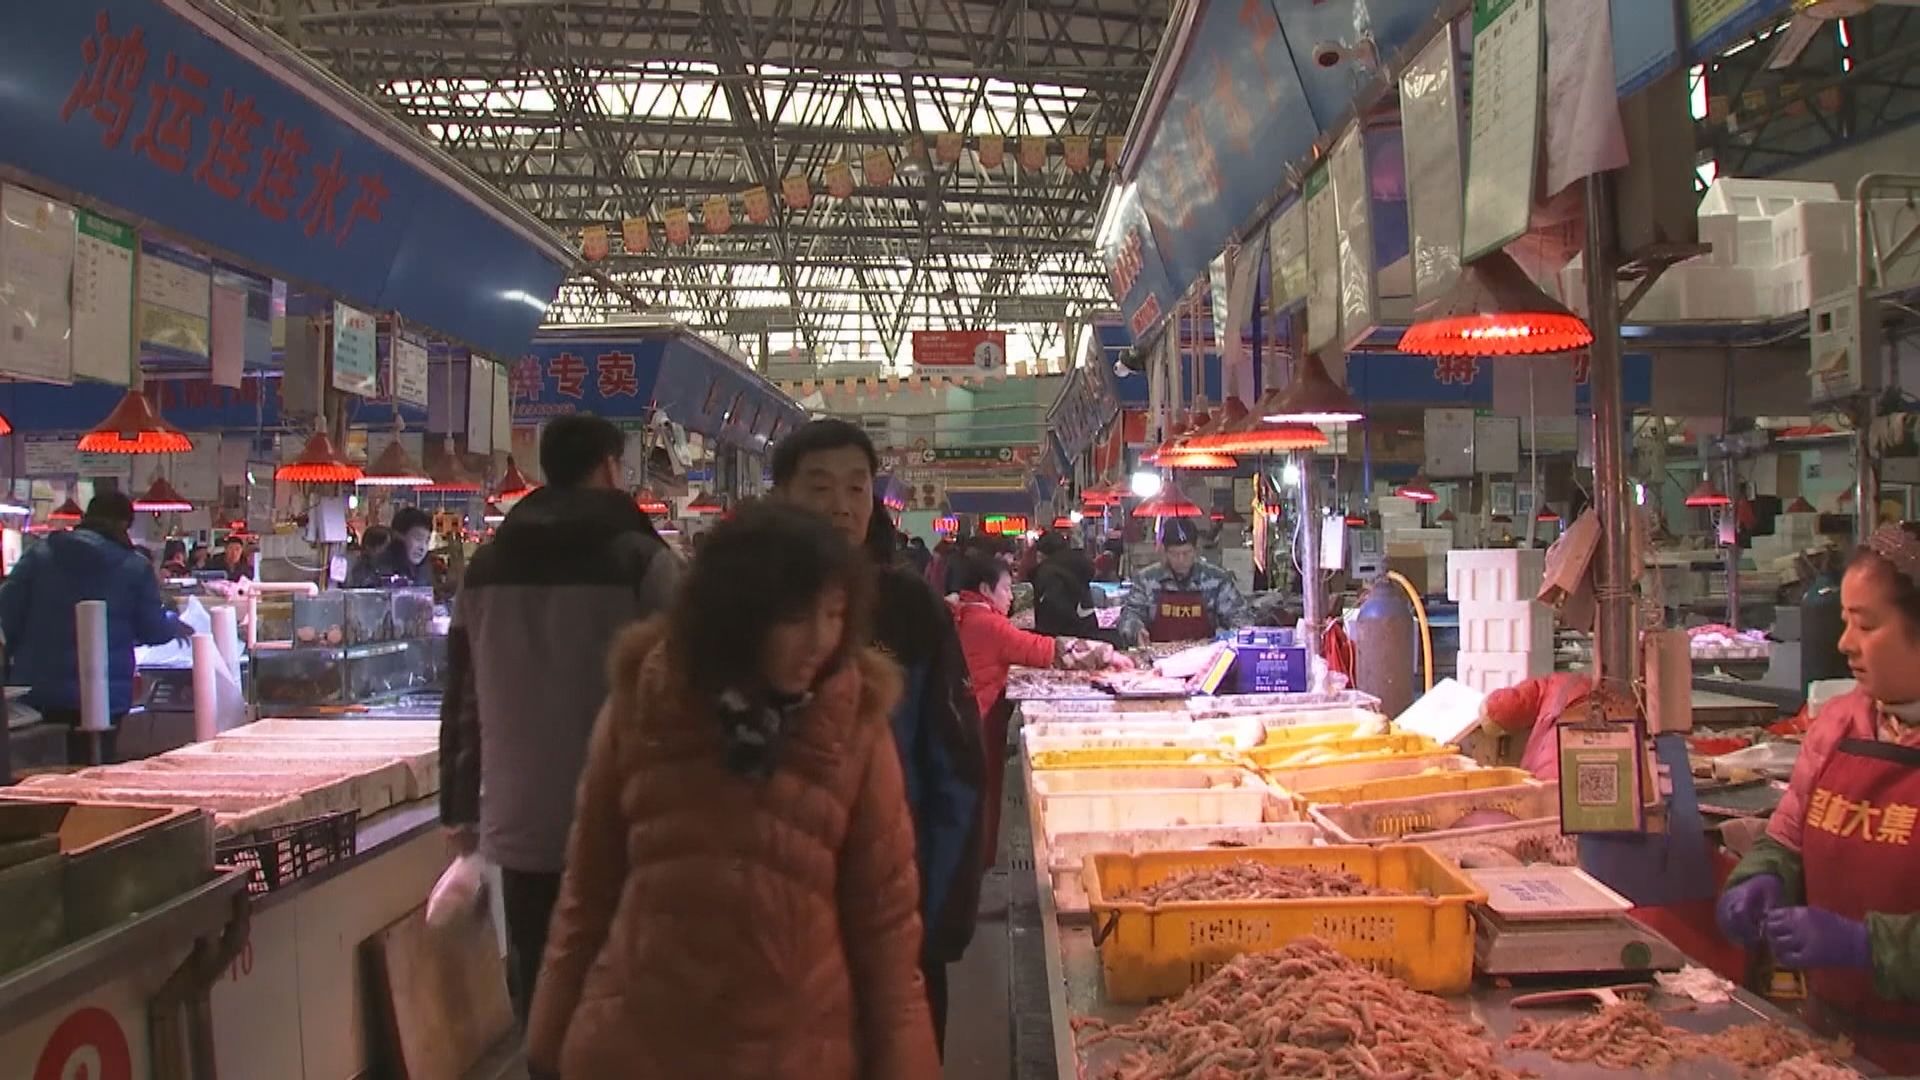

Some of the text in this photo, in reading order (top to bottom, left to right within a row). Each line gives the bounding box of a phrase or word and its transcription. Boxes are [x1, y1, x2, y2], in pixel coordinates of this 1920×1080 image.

[60, 8, 390, 247] 鸿运连连水产
